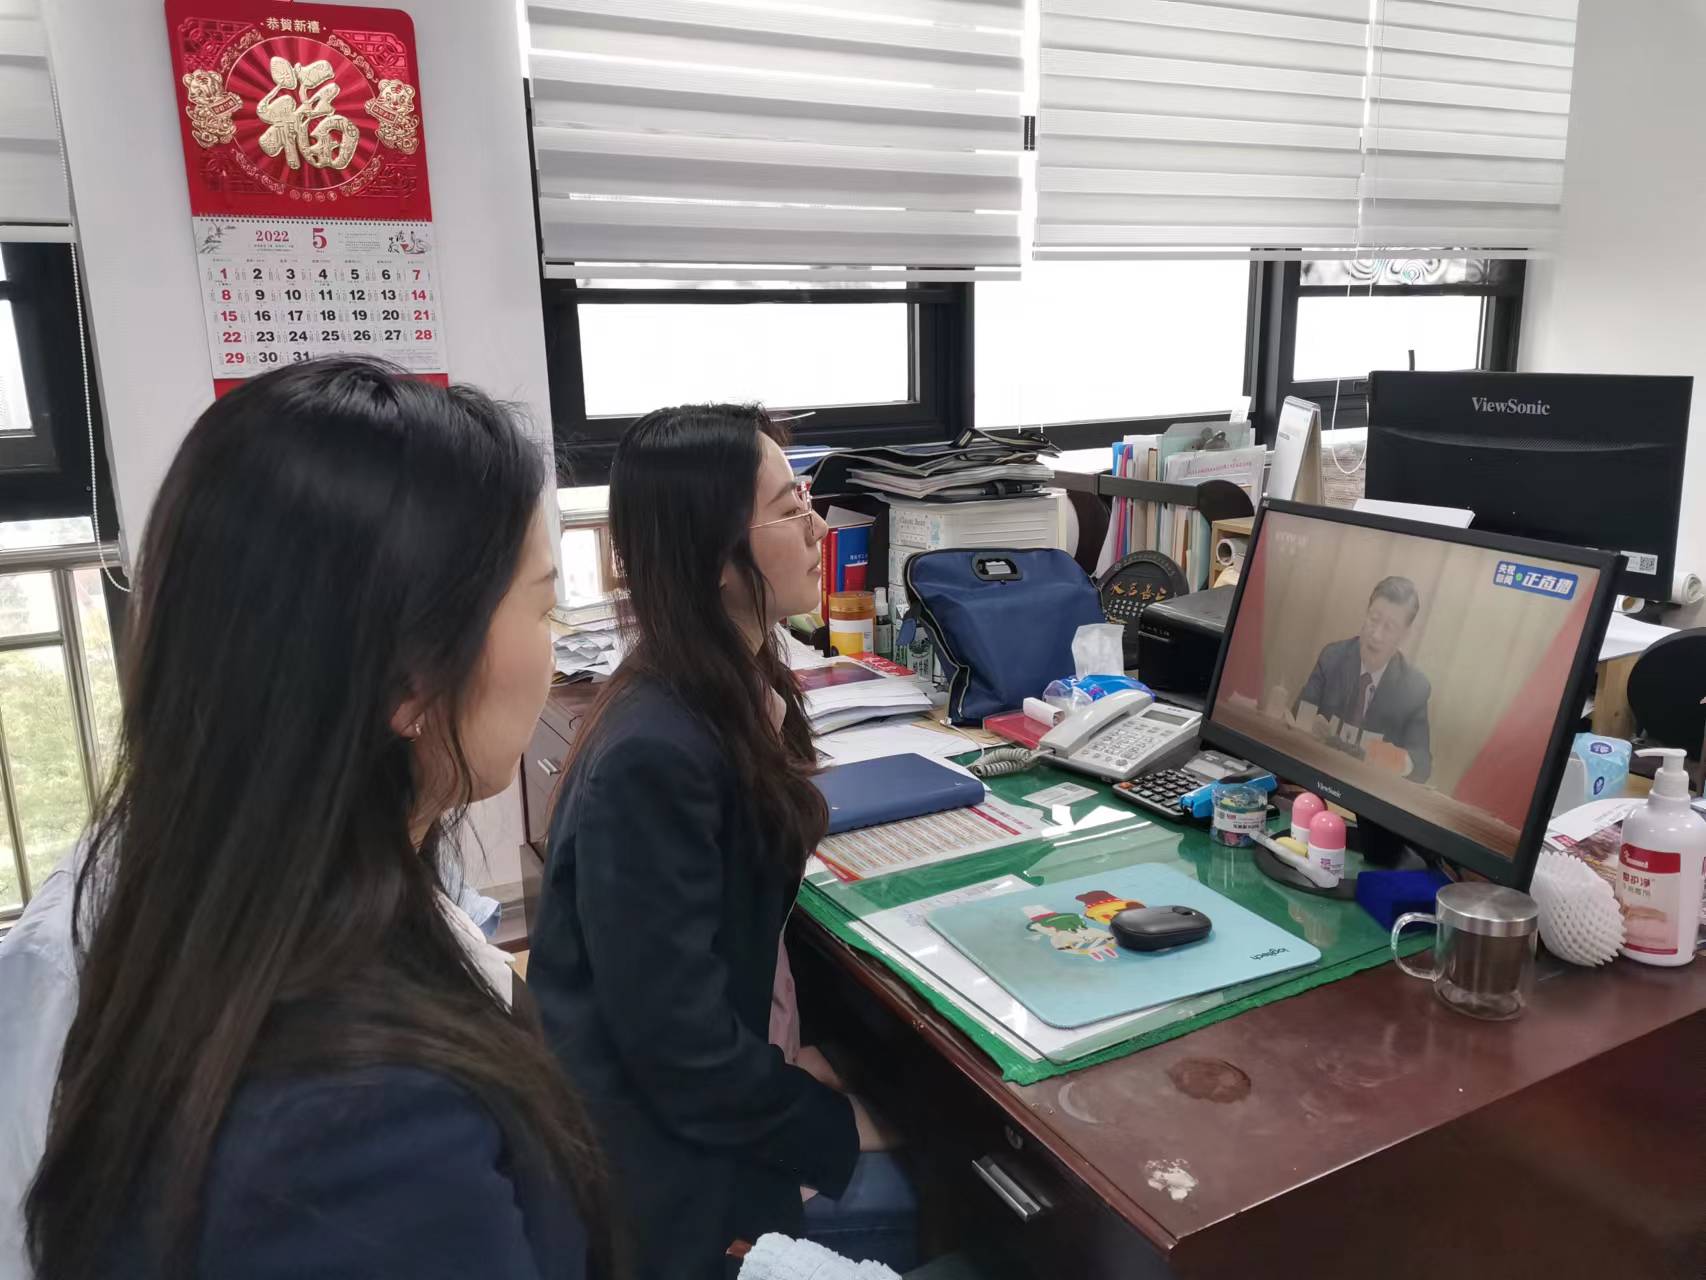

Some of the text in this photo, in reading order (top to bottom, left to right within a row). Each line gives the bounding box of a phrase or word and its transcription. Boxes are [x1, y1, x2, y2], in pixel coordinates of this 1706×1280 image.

[265, 17, 321, 34] 恭賀新禧
[256, 56, 360, 170] 福
[255, 230, 290, 242] 2022
[312, 227, 328, 249] 5
[221, 268, 421, 280] 1 2 3 4 5 6 7
[221, 290, 427, 301] 8 9 10 11 12 13 14
[220, 310, 430, 322] 15 16 17 18 19 20 21
[223, 330, 433, 343] 22 23 24 25 26 27 28
[225, 351, 311, 363] 29 30 31
[1472, 397, 1550, 415] ViewSonic
[1249, 947, 1291, 961] logitech
